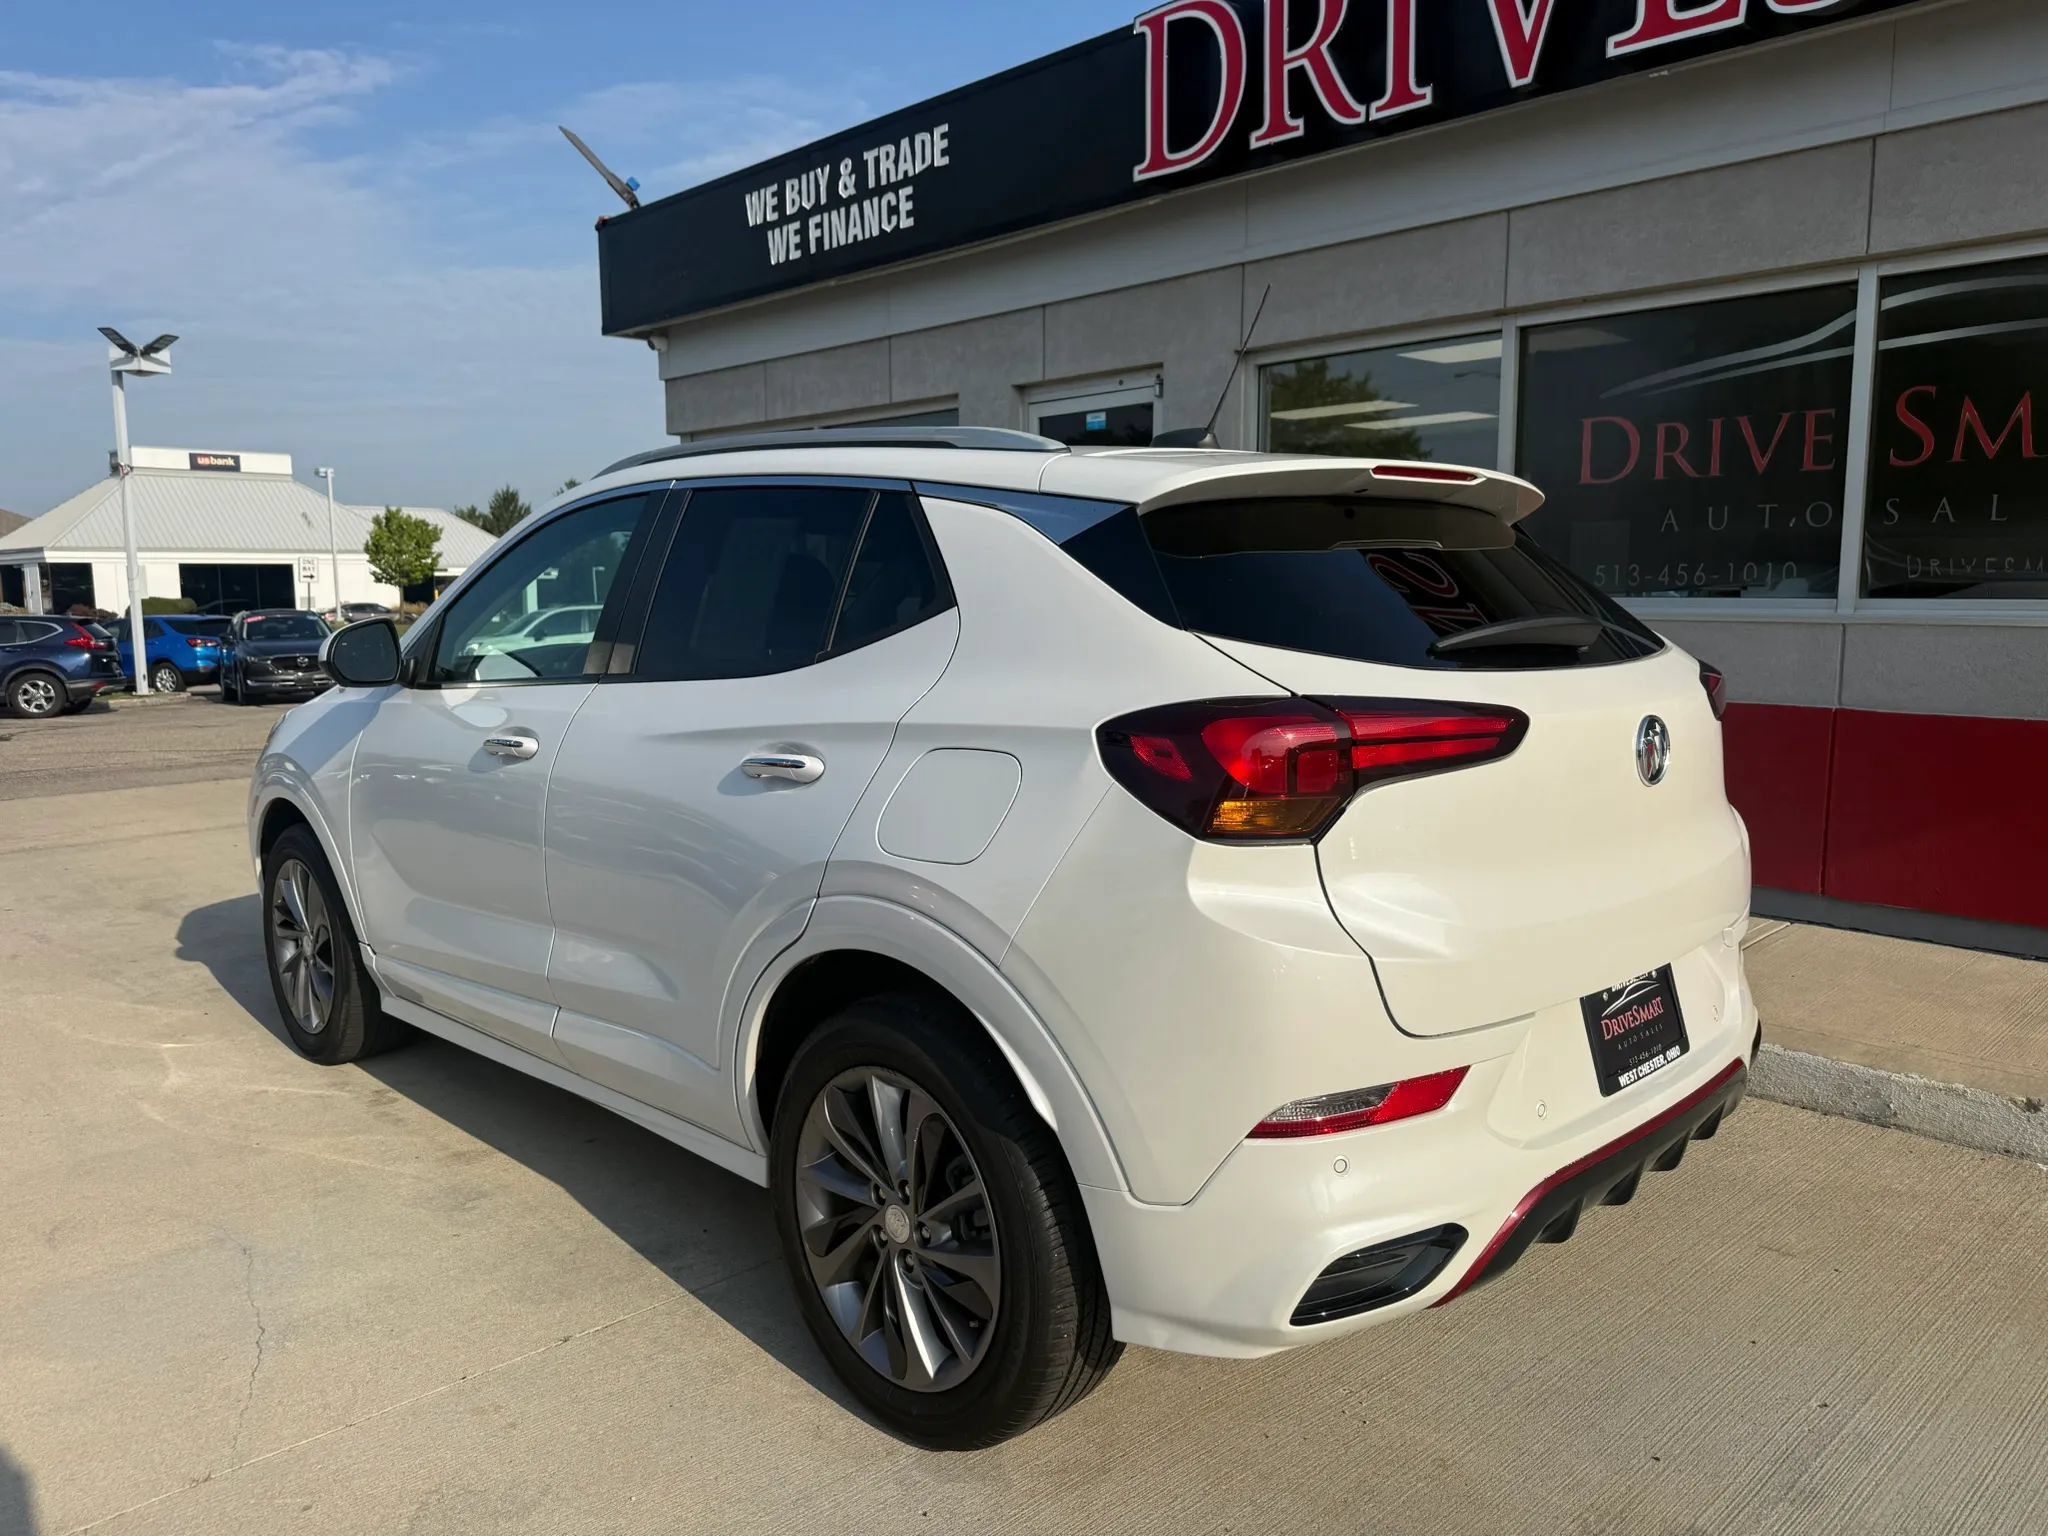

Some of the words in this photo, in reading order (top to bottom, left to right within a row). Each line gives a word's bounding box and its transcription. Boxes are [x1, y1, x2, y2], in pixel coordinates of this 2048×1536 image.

[1133, 0, 1845, 182] DRI
[745, 183, 779, 227] WE
[786, 164, 830, 216] BUY
[838, 157, 856, 199] &
[863, 123, 950, 189] TRADE
[767, 221, 802, 266] WE
[809, 185, 914, 255] FINANCE
[1577, 408, 1836, 485] DRIVE
[1889, 384, 2048, 468] SM
[1660, 501, 1833, 533] AUTO
[1883, 494, 2048, 525] SAL
[1594, 561, 1797, 586] 513-456-1010
[1601, 997, 1664, 1040] DRIVESMART
[1618, 1068, 1638, 1087] WEST
[1665, 1044, 1681, 1062] OHIO
